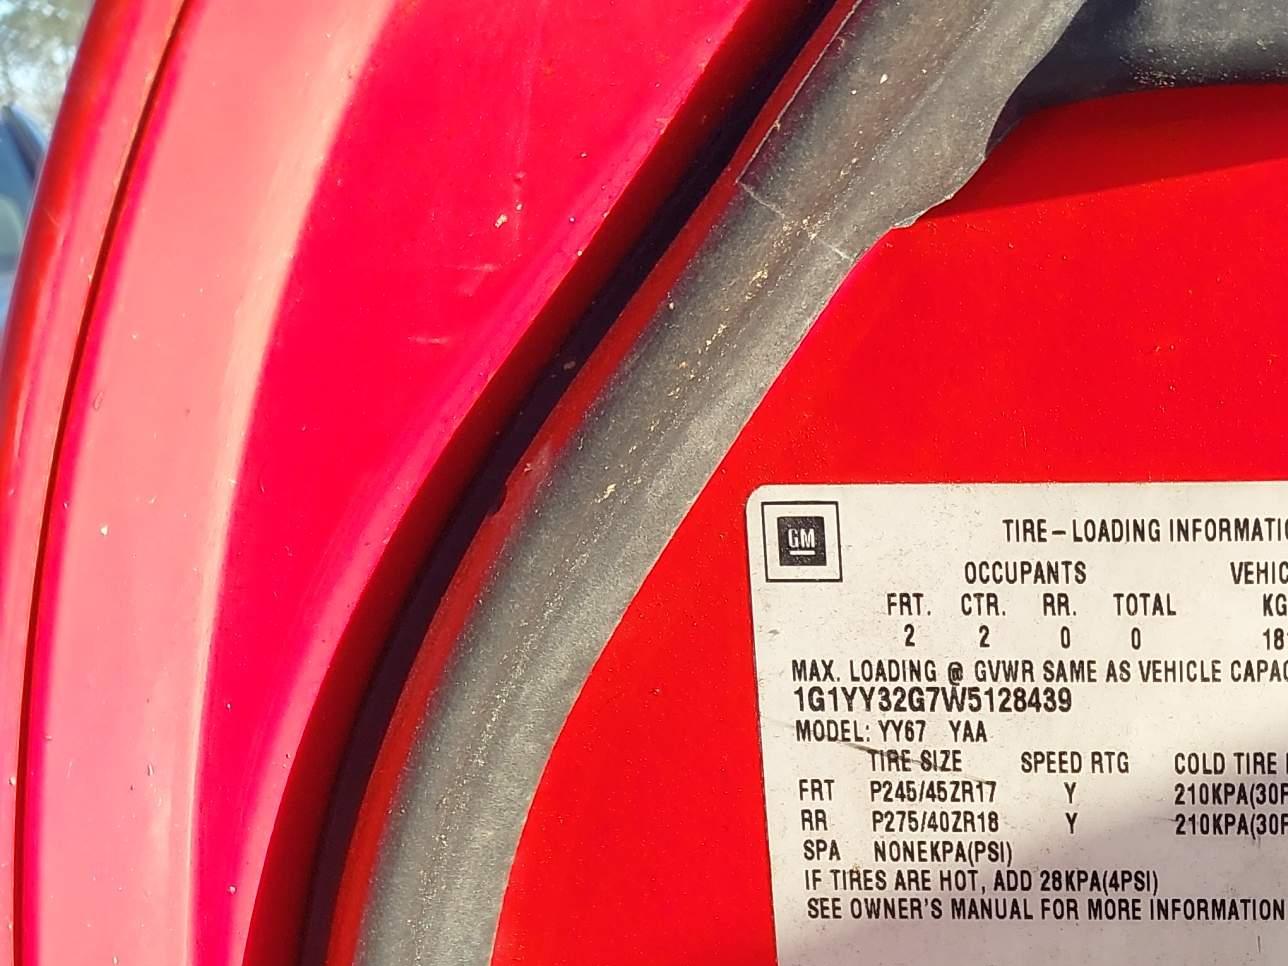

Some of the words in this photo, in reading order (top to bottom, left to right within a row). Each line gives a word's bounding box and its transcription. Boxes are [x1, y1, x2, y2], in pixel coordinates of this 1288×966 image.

[788, 527, 816, 549] GM
[964, 561, 1087, 585] OCCUPANTS
[887, 593, 931, 616] FRT.
[961, 593, 1006, 616] CTR.
[1042, 593, 1077, 616] RR.
[1113, 593, 1176, 616] TOTAL
[1262, 593, 1288, 617] KG
[904, 624, 916, 647] 2
[979, 625, 990, 648] 2
[1060, 626, 1071, 649] 0
[1131, 627, 1141, 650] 0
[792, 659, 840, 682] MAX.
[850, 660, 937, 682] LOADING
[947, 661, 963, 686] @
[975, 660, 1035, 682] GVWR
[1043, 660, 1097, 682] SAME
[1106, 660, 1130, 682] AS
[1139, 660, 1222, 683] VEHICLE
[793, 686, 1072, 713] 1G1YY32G7W5128439
[796, 720, 871, 742] MODEL:
[878, 720, 926, 743] YY67
[949, 720, 987, 743] YAA
[869, 750, 912, 772] TIRE
[920, 750, 962, 772] SIZE
[1021, 751, 1083, 774] SPEED
[1091, 751, 1129, 774] RTG
[1174, 752, 1225, 775] COLD
[1233, 752, 1277, 775] TIRE
[799, 779, 835, 801] FRT
[870, 780, 997, 803] P245/45ZR17
[1064, 782, 1076, 804] Y
[801, 809, 828, 832] RR
[872, 810, 999, 833] P275/40ZR18
[1065, 812, 1078, 834] Y
[803, 840, 840, 861] SPA
[874, 840, 1012, 868] NONEKPA(PSI)
[805, 870, 821, 890] IF
[830, 869, 886, 890] TIRES
[895, 869, 931, 891] ARE
[940, 870, 986, 894] HOT,
[993, 870, 1032, 892] ADD
[1040, 870, 1158, 896] 28KPA(4PSI)
[807, 898, 842, 919] SEE
[850, 898, 943, 920] OWNER'S
[951, 898, 1033, 920] MANUAL
[1041, 898, 1079, 920] FOR
[1088, 898, 1141, 920] MORE
[1150, 898, 1285, 921] INFORMATION
